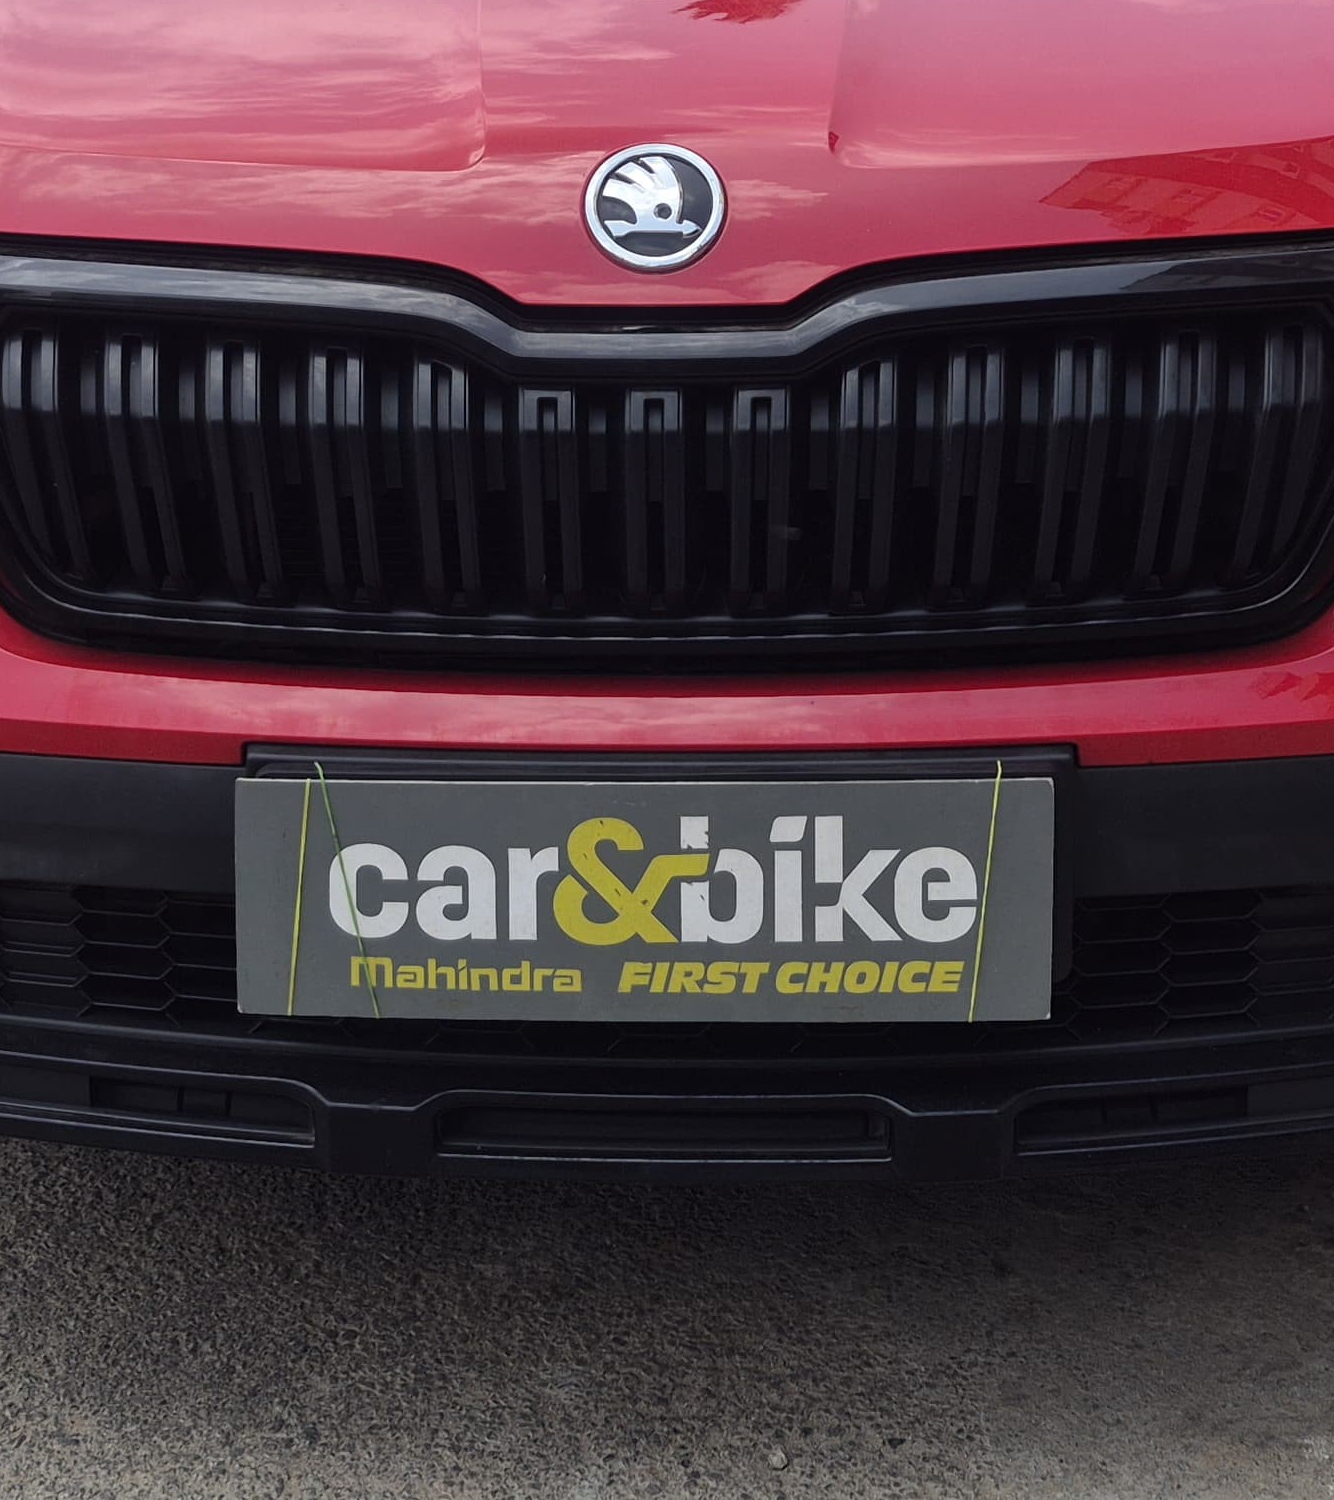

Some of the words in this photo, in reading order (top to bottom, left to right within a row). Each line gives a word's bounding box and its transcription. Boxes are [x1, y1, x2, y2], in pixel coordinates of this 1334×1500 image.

[329, 815, 978, 946] car&bike
[350, 956, 582, 992] Mahindra
[617, 961, 771, 994] FIRST
[774, 961, 965, 994] CHOICE
